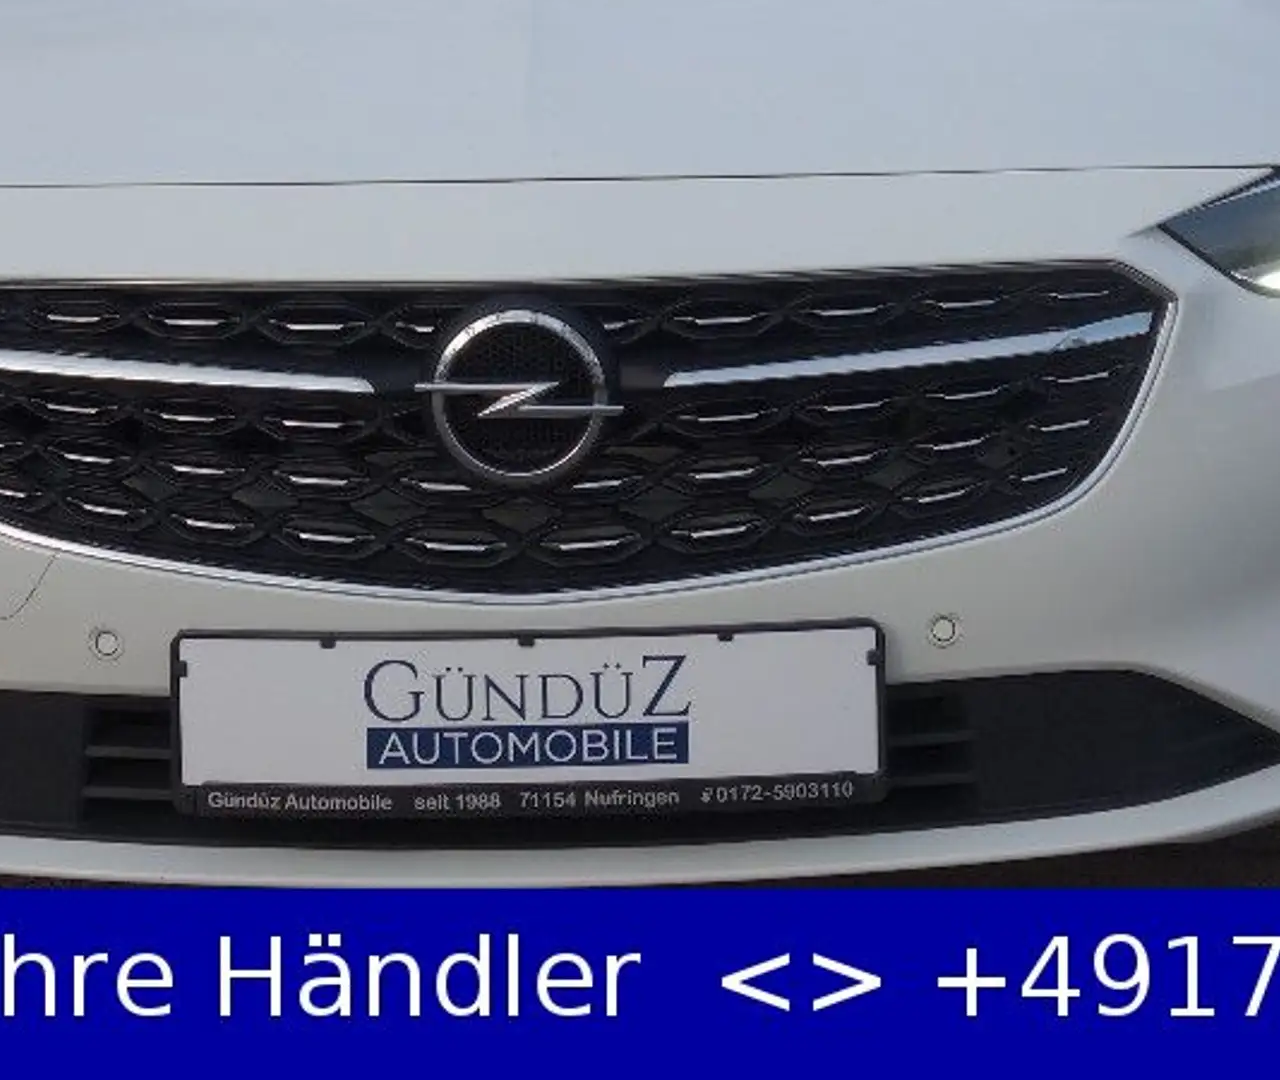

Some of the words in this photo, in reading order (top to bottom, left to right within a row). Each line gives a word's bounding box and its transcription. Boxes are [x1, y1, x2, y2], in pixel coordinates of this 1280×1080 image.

[362, 654, 692, 724] GÜNDÜZ
[377, 727, 677, 765] AUTOMOBILE
[207, 791, 281, 810] Gündüz
[284, 792, 393, 811] Automobile
[414, 792, 449, 811] seit
[455, 791, 501, 811] 1988
[519, 790, 577, 808] 71154
[583, 788, 680, 810] Nufringen
[716, 781, 854, 803] 0172-5903110
